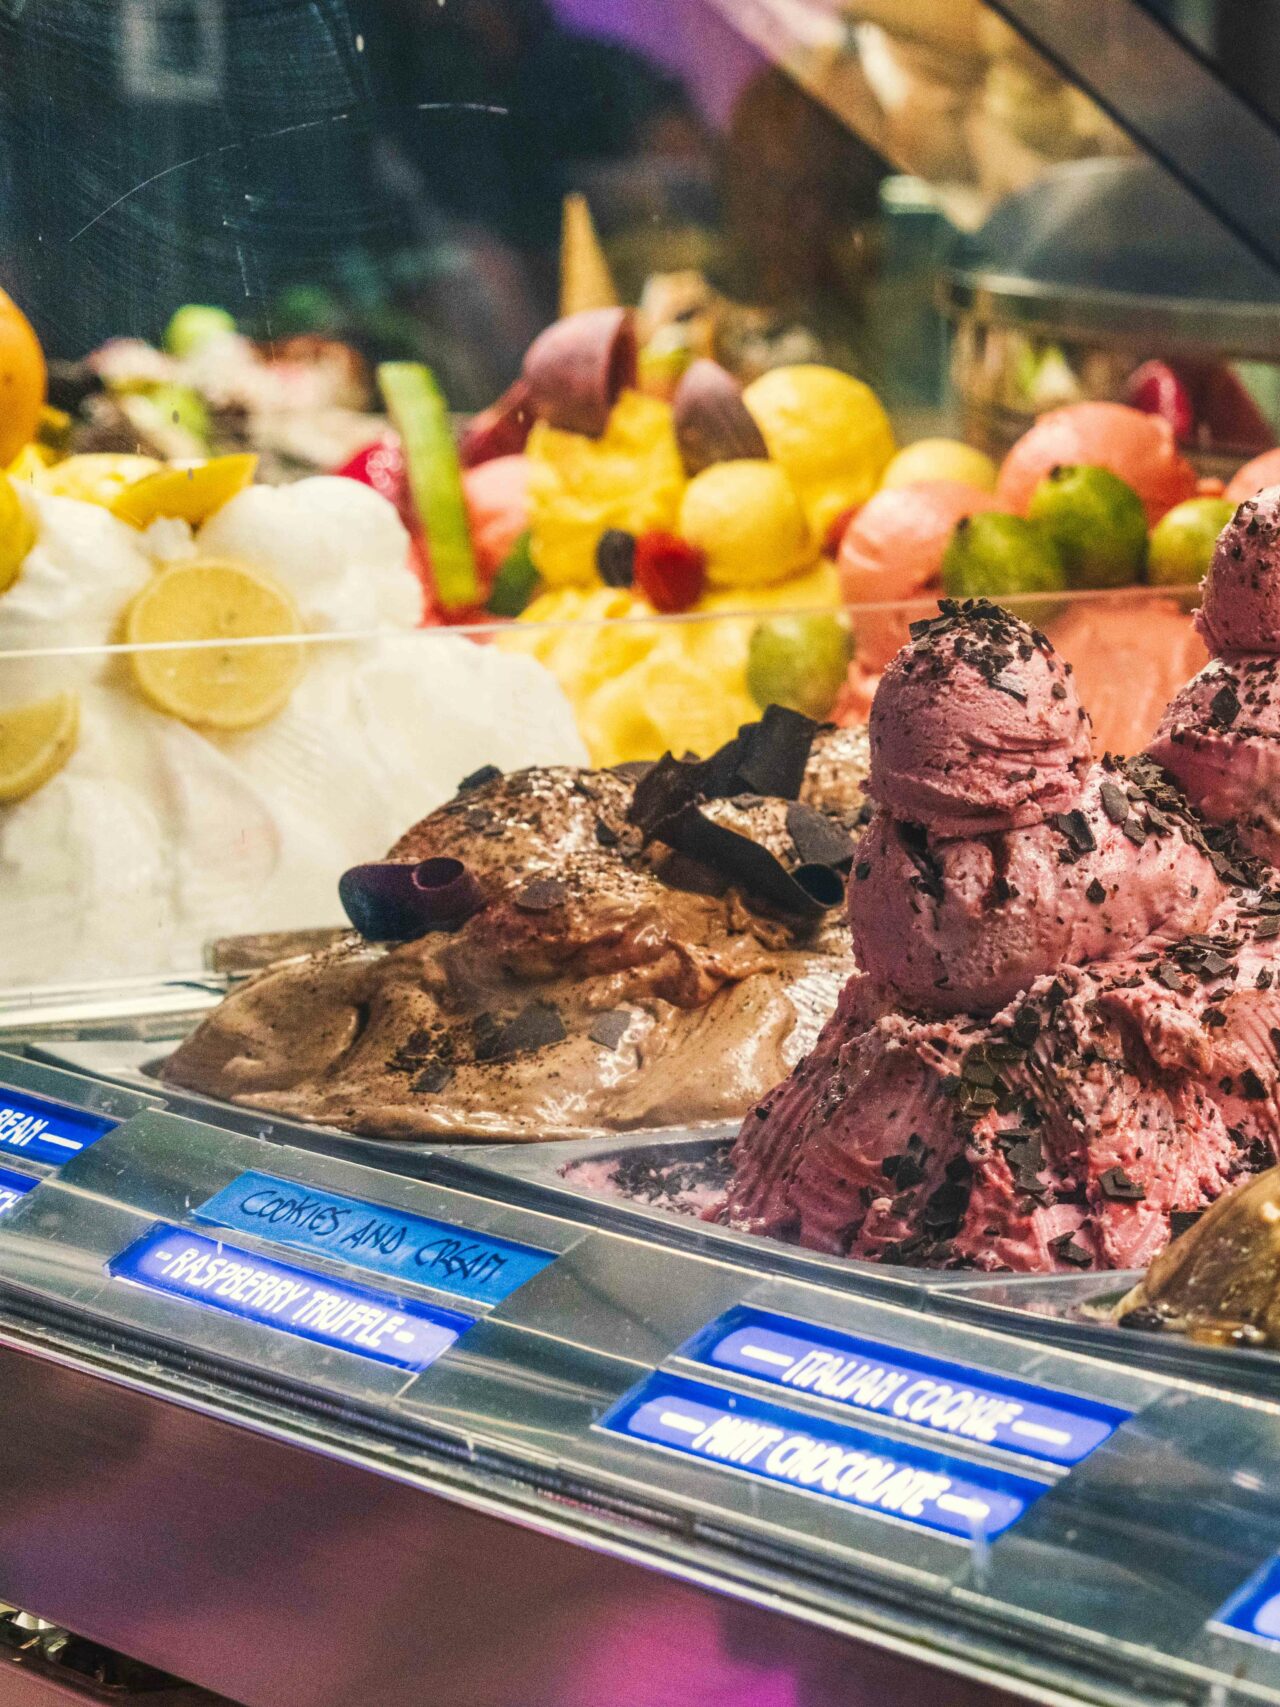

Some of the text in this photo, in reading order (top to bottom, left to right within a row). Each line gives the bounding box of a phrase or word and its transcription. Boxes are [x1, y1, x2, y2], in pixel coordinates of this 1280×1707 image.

[239, 1190, 508, 1284] COOKIES AND CREAM
[161, 1247, 405, 1348] RASPBERRY TRUFFLE
[781, 1350, 1024, 1442] ITALIAN COOKIE
[691, 1415, 952, 1517] MINT CHOCOLATE
